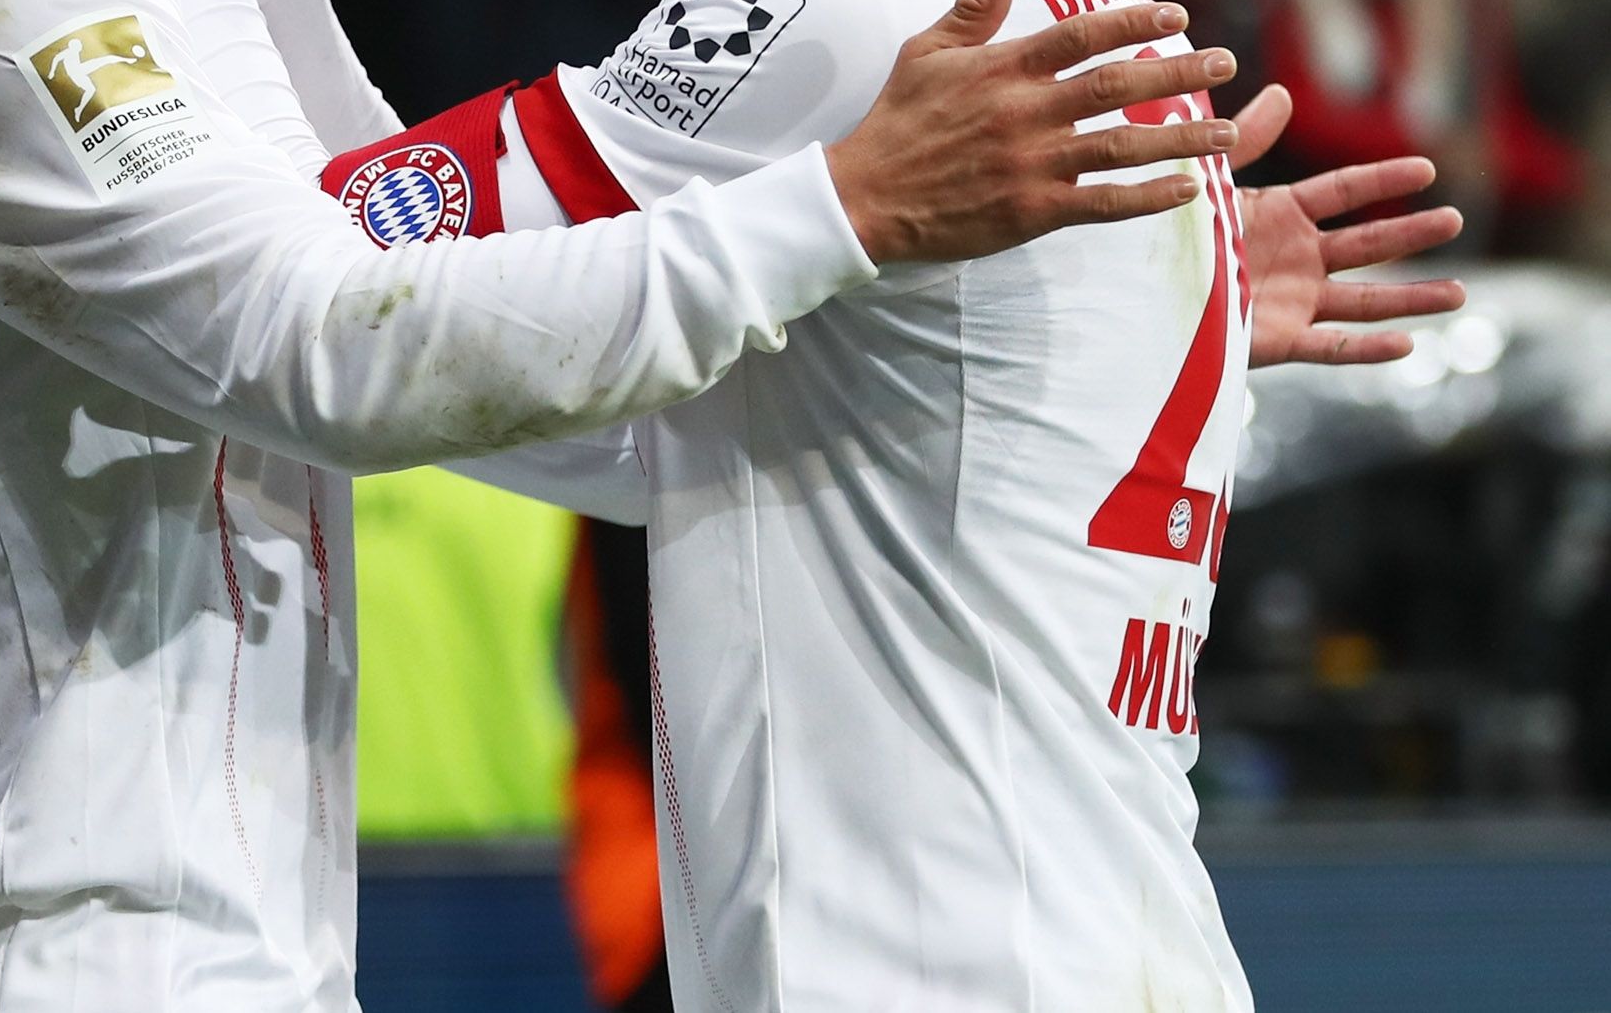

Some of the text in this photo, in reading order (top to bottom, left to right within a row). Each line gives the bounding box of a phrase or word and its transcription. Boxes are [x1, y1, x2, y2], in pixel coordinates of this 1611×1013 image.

[81, 98, 187, 153] BUNDESLIGA
[106, 133, 211, 190] FUSSBALLMEISTER
[118, 129, 186, 167] DEUTSCHER
[135, 148, 195, 184] 2016/2017
[406, 149, 437, 168] FC
